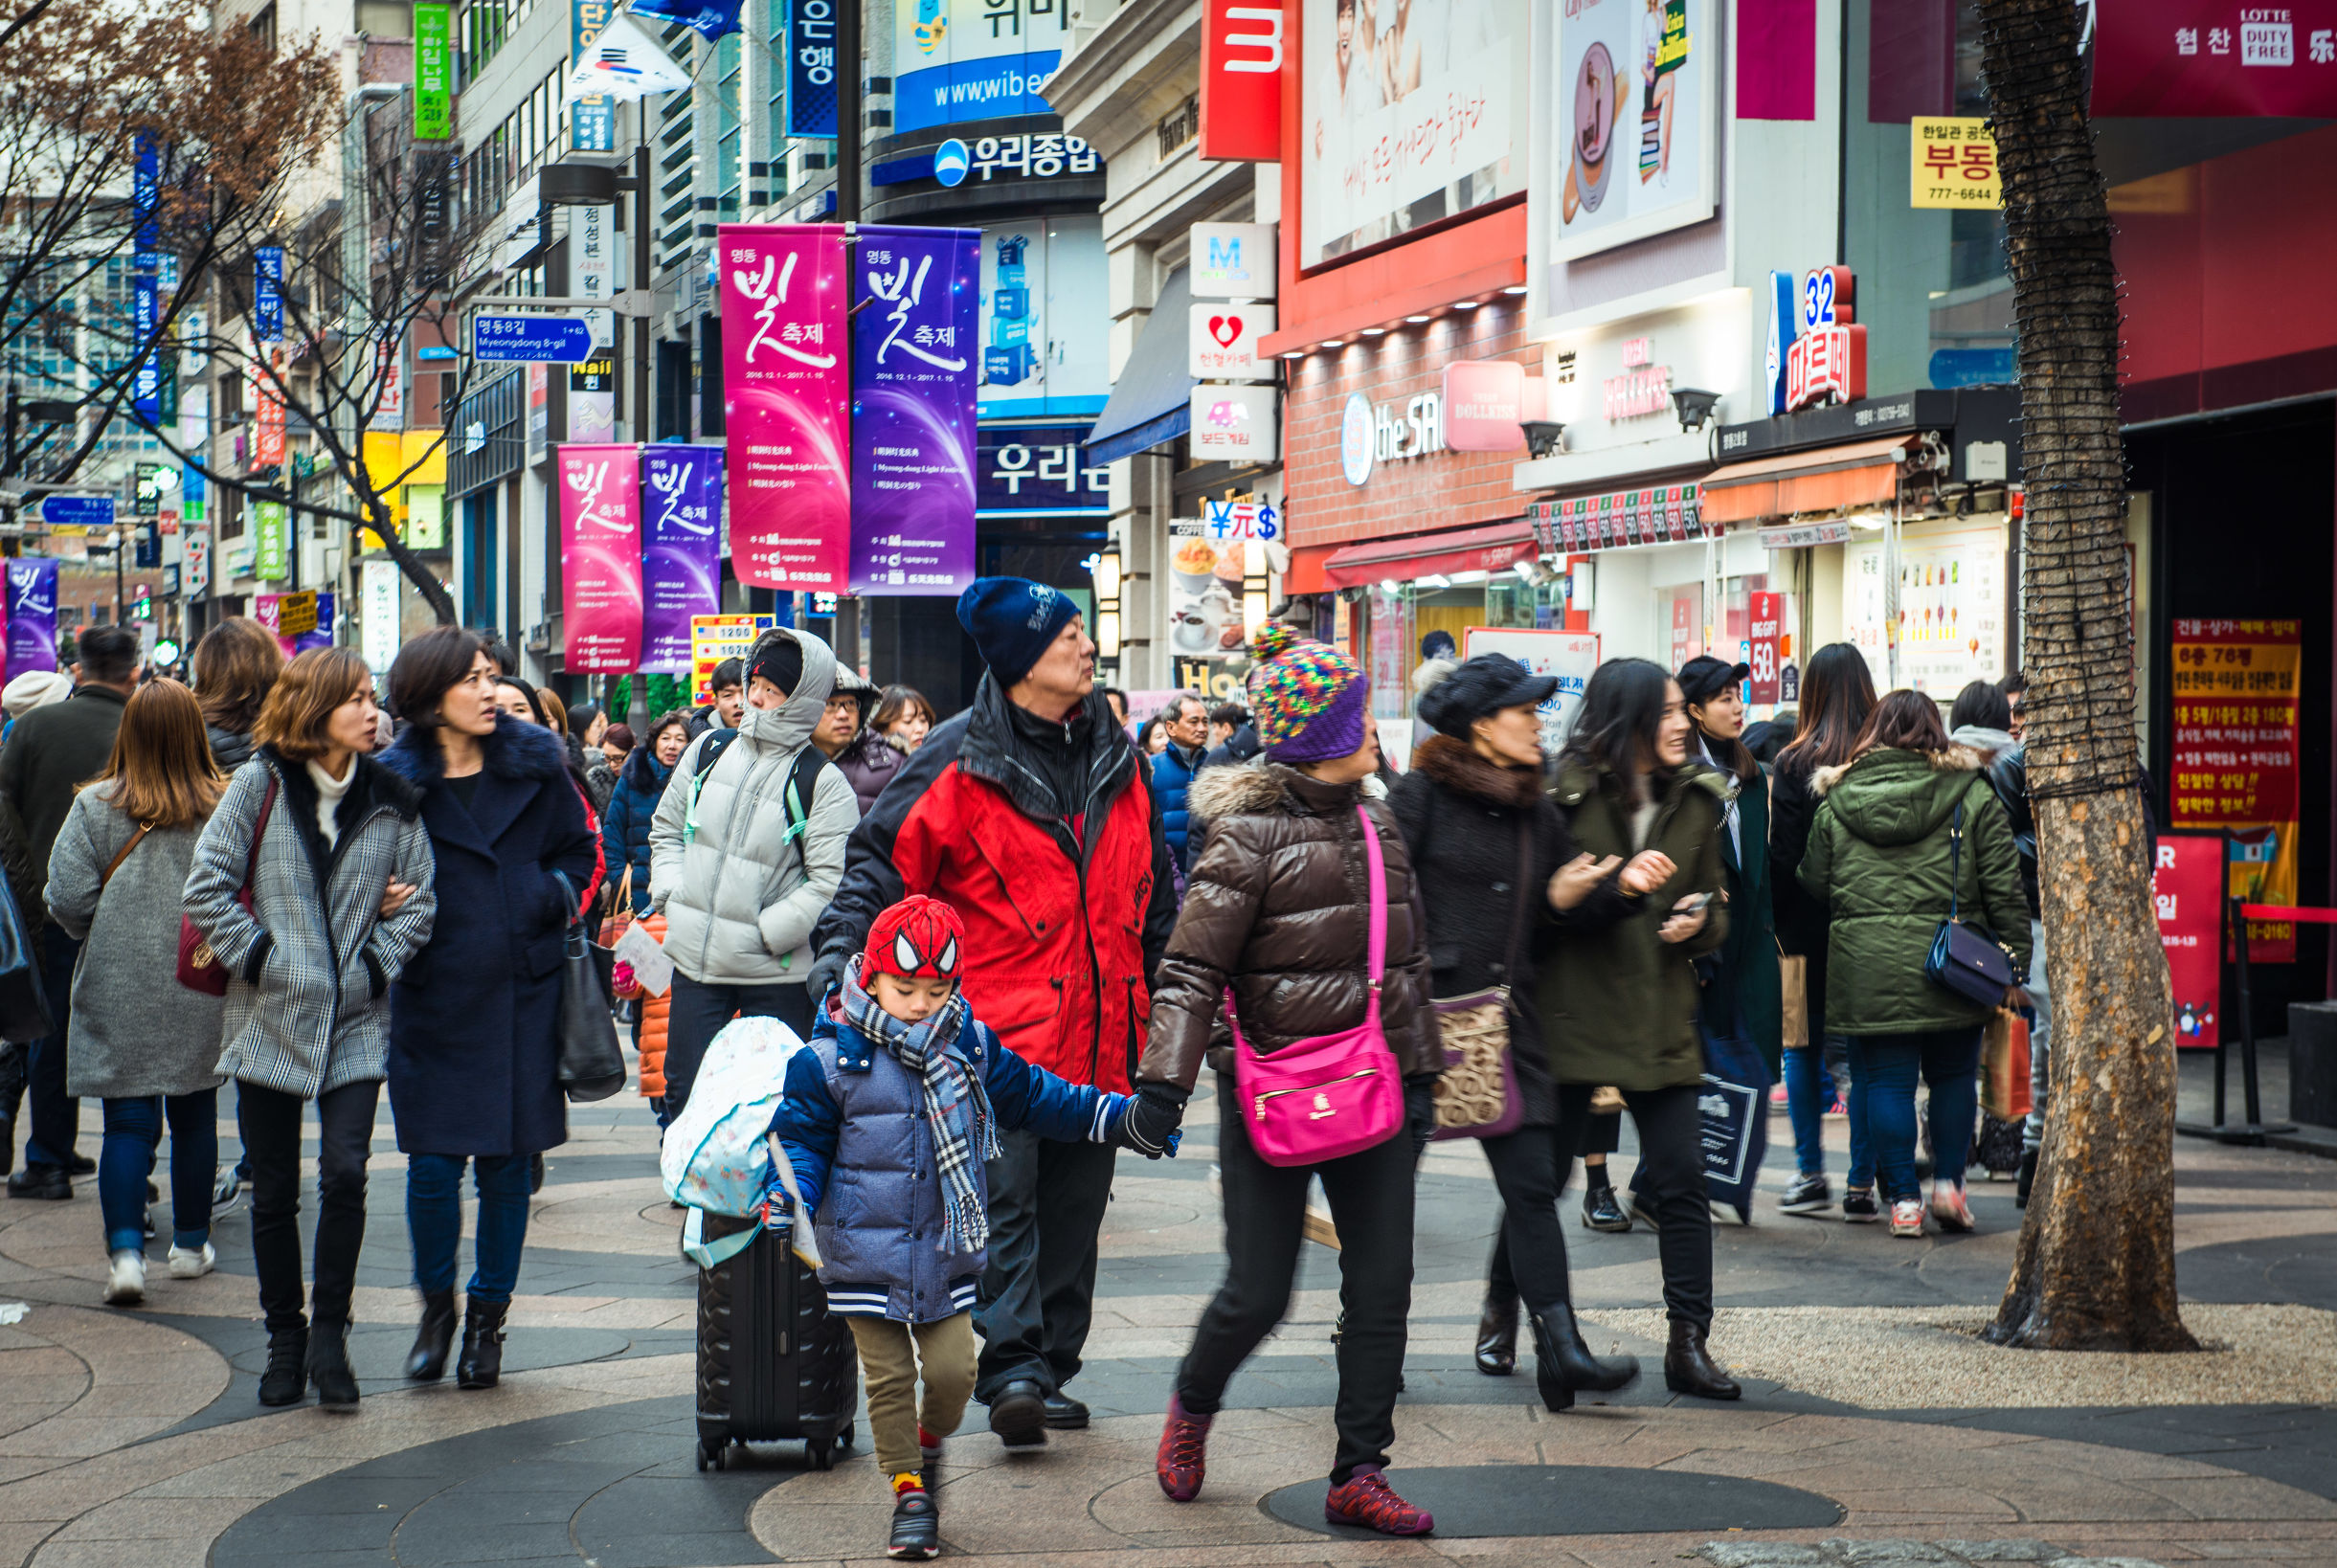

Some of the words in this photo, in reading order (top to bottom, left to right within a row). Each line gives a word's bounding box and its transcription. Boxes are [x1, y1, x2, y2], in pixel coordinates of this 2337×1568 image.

[2240, 9, 2291, 22] LOTTE
[2247, 30, 2288, 42] DUTY
[2248, 45, 2288, 58] FREE
[1923, 125, 1961, 140] 한일관
[1924, 145, 1993, 180] 부동
[1929, 188, 1990, 199] 777-6644
[730, 249, 757, 263] 명동
[866, 250, 892, 264] 명동
[1209, 237, 1242, 268] M
[1807, 273, 1833, 327] 32
[478, 320, 526, 335] 명동8길
[781, 323, 823, 345] 축제
[478, 337, 542, 349] Myeongdong
[544, 338, 566, 349] 8-gil
[913, 325, 955, 347] 축제
[573, 360, 611, 374] Nail
[1200, 353, 1251, 367] 헌혈카페
[1455, 403, 1517, 420] DOLLKISS
[1202, 433, 1250, 445] 보드게임
[1376, 404, 1404, 461] the
[598, 504, 626, 518] 축제
[681, 505, 708, 520] 축제
[720, 628, 750, 638] 1200
[2177, 772, 2215, 790] 친절한
[2177, 796, 2215, 814] 정확한
[2157, 845, 2176, 868] R
[2156, 893, 2176, 920] 일
